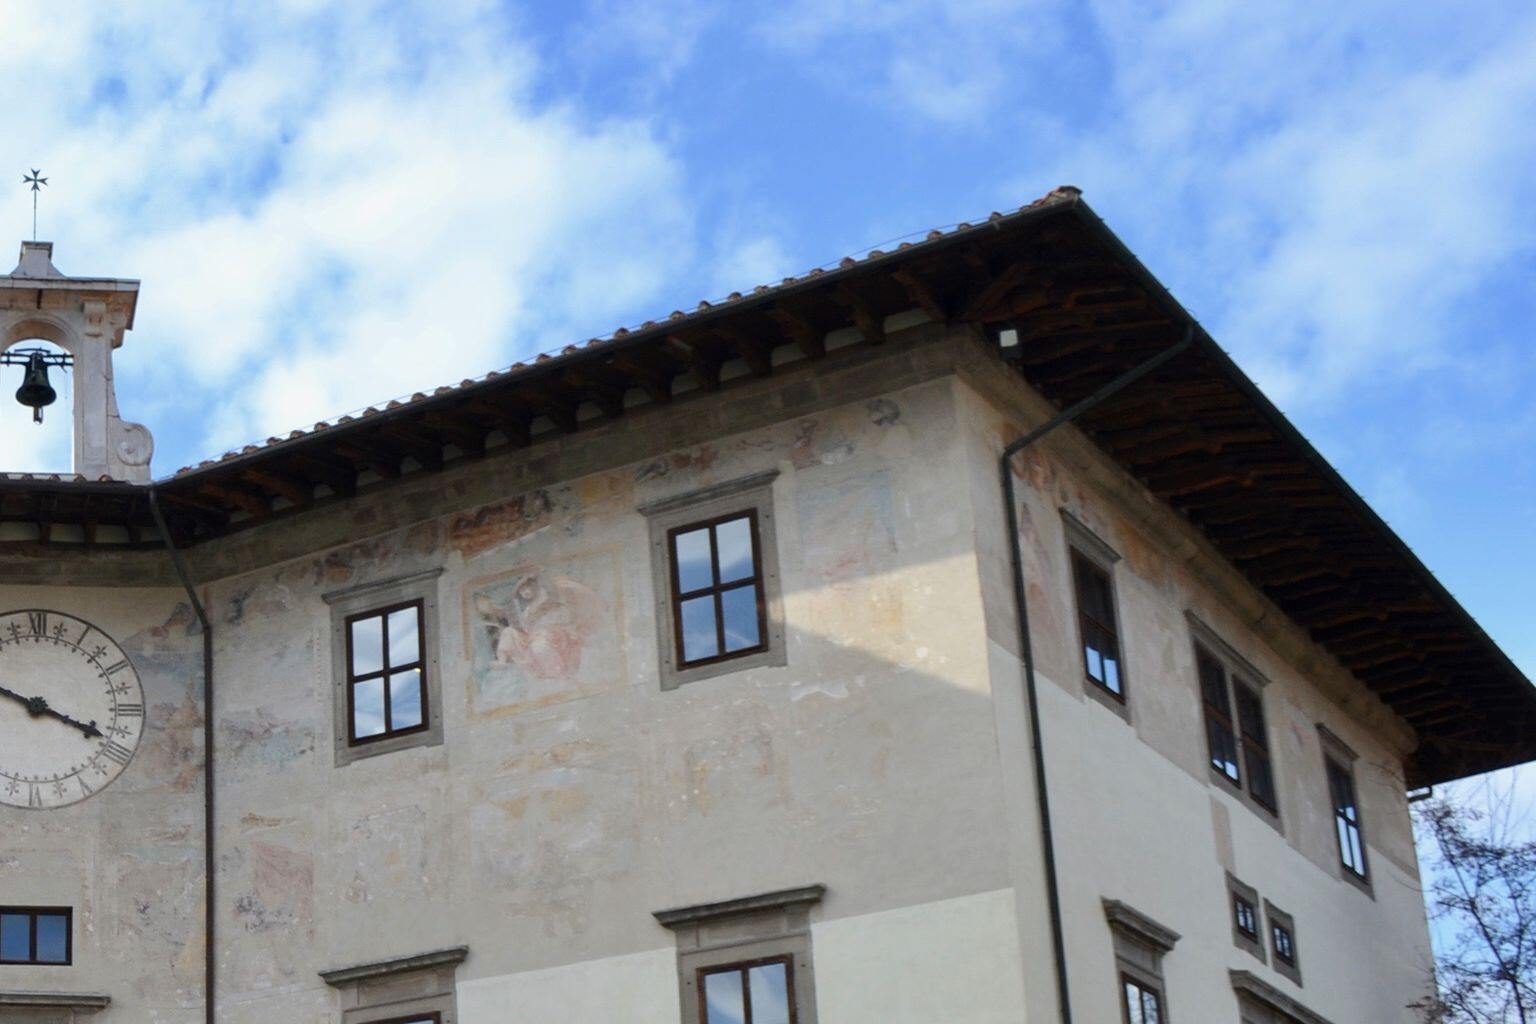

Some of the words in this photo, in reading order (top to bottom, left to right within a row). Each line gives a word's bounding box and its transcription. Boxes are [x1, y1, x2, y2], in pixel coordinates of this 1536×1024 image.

[28, 613, 47, 636] XII
[105, 660, 129, 675] II
[118, 703, 142, 717] III
